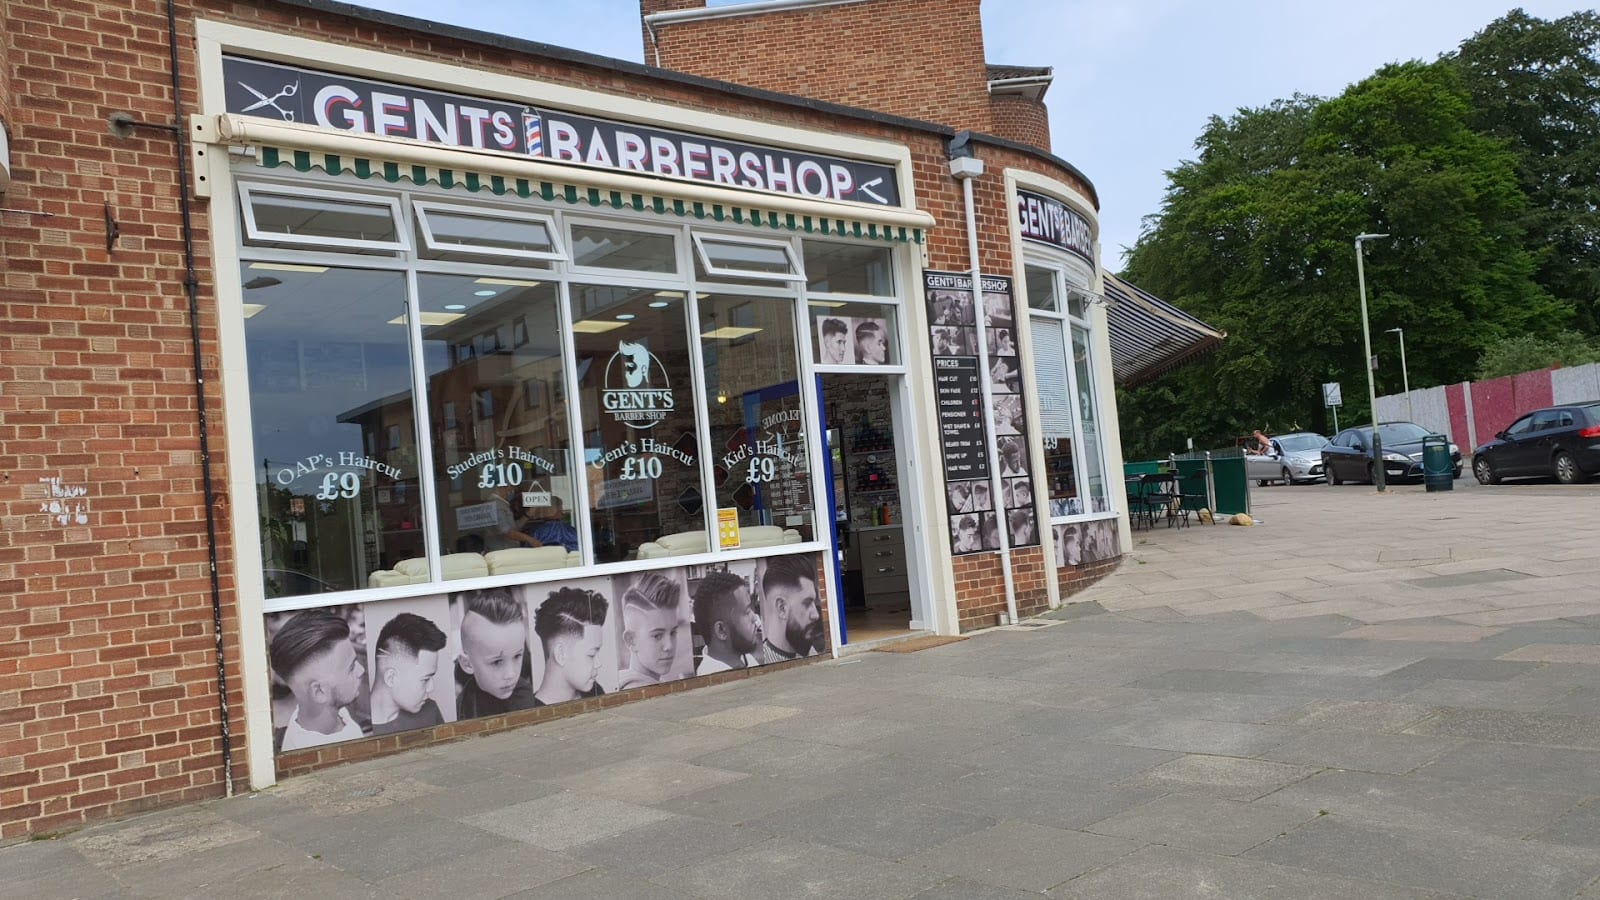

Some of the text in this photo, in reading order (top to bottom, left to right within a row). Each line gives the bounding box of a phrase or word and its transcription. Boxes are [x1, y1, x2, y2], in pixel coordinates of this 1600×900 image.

[313, 85, 855, 200] GENTS BARBERSHOP
[957, 279, 1007, 291] BARRSHOP
[936, 359, 959, 367] PRICES
[603, 391, 674, 410] GENT'S
[614, 411, 667, 421] BARBER SHOP
[591, 438, 696, 469] Gent's Haircut
[722, 440, 799, 469] Kid's Haircut
[1044, 434, 1058, 450] £9
[277, 451, 402, 485] OAP's Haircut
[508, 445, 555, 474] Haircut
[620, 456, 662, 480] £10
[746, 457, 775, 483] £9
[316, 472, 360, 500] £9
[478, 463, 523, 489] £10
[525, 495, 549, 503] OPEN
